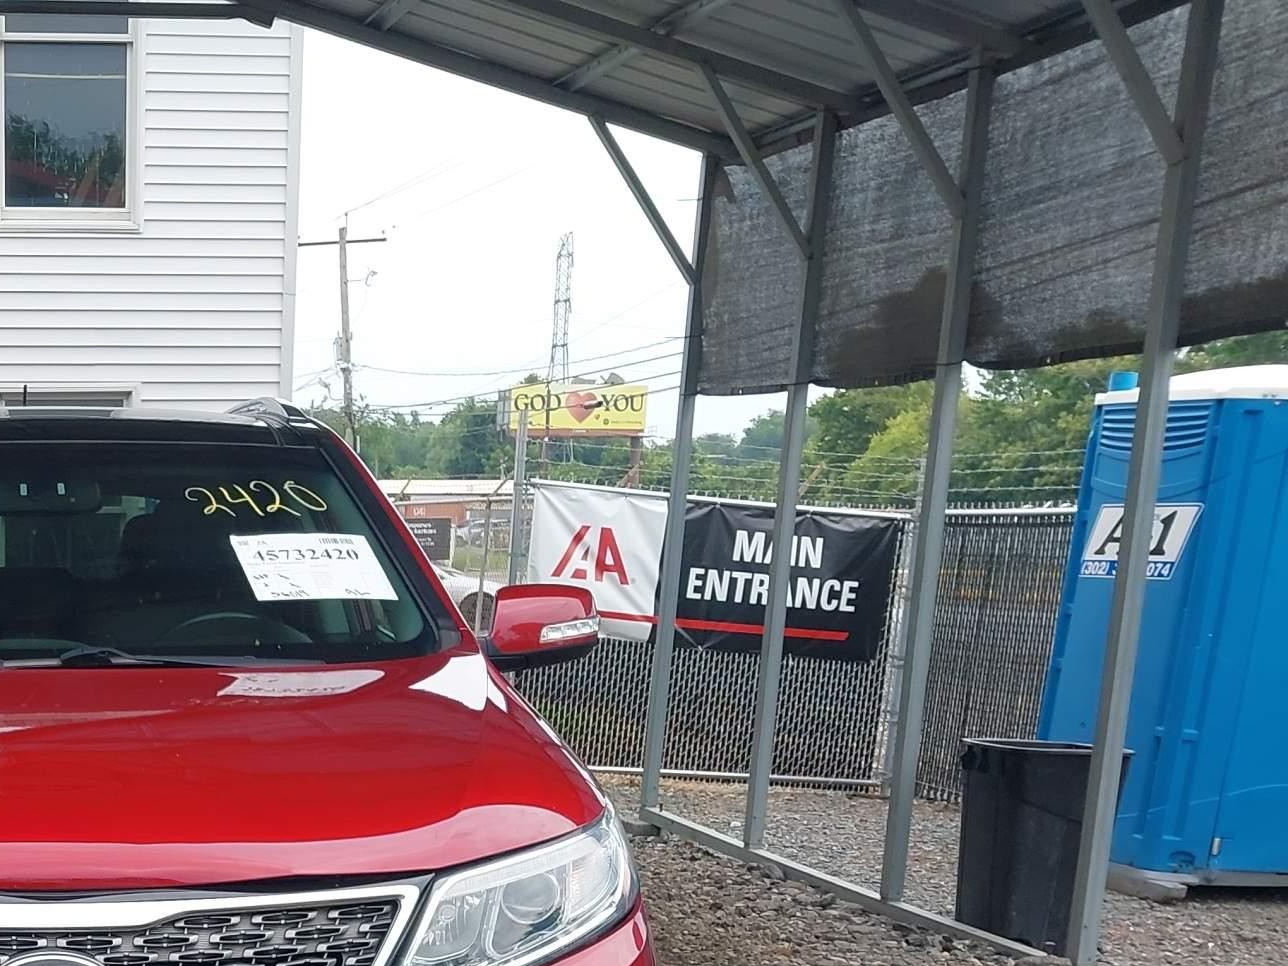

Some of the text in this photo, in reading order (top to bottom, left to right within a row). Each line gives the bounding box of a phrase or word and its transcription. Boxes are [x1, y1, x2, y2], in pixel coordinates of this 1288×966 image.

[514, 394, 645, 412] GOD YOU
[184, 480, 328, 517] 2420
[252, 548, 360, 562] 45732420
[1081, 561, 1111, 575] (302)
